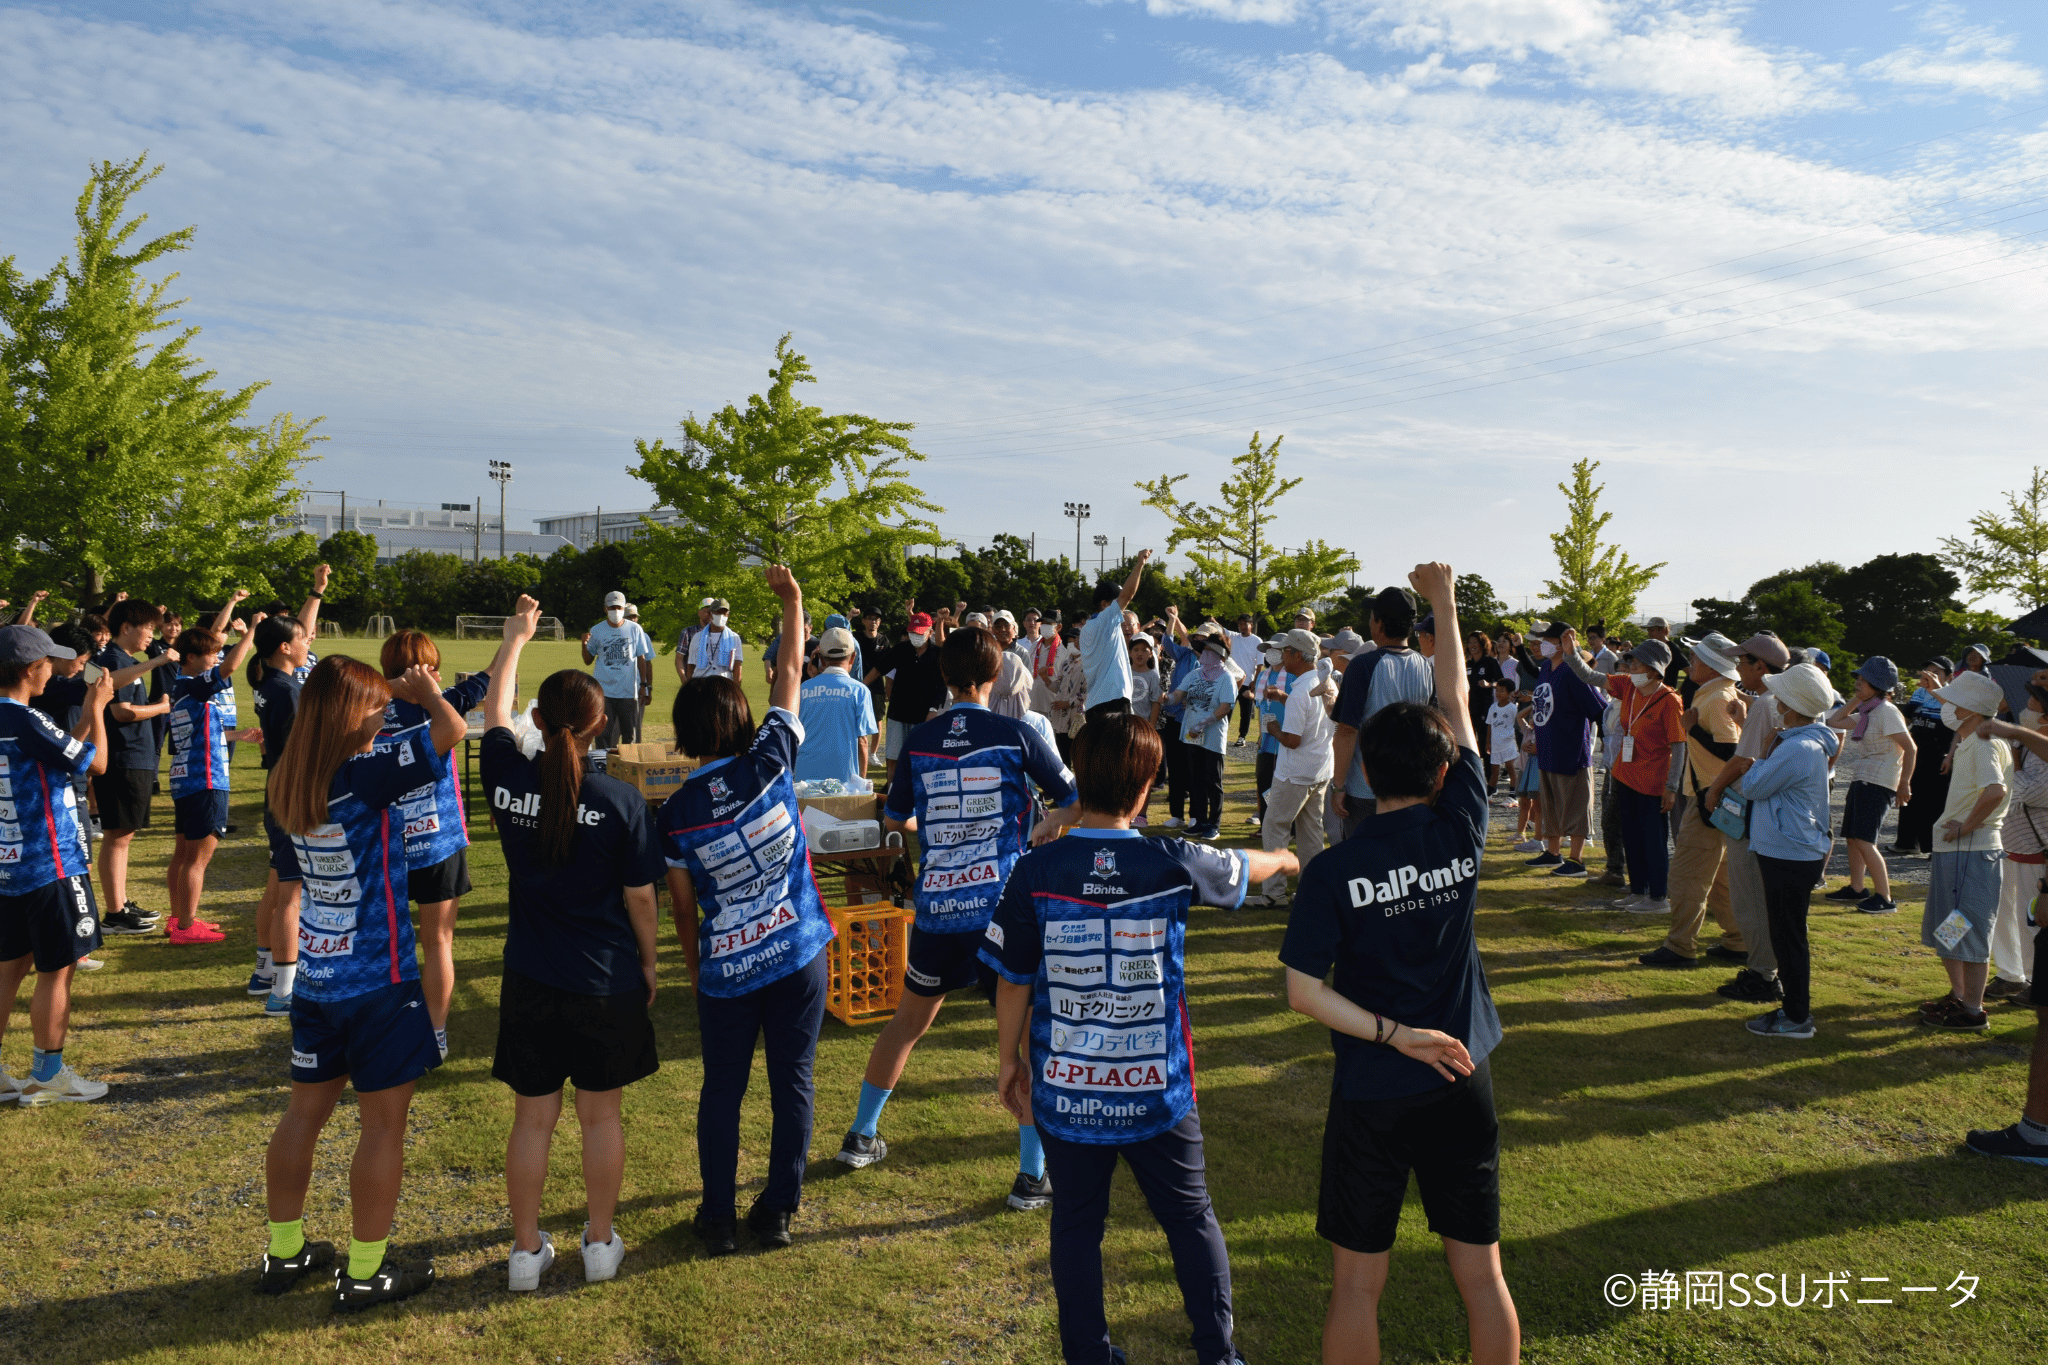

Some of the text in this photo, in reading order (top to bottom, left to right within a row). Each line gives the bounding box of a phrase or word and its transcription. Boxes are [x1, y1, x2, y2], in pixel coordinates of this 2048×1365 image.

[966, 796, 995, 806] GREEN
[966, 803, 996, 814] WORKS
[933, 825, 998, 844] 山下クリニック
[314, 854, 345, 863] GREEN
[317, 862, 349, 873] WORKS
[1082, 883, 1125, 895] Bonita
[1347, 857, 1476, 908] DalPonte
[930, 896, 989, 914] DalPonte
[1384, 889, 1459, 917] DESDE 1930
[721, 940, 791, 977] DalPonte
[764, 955, 784, 968] 1930
[1119, 960, 1158, 971] GREEN
[1119, 970, 1159, 981] WORKS
[1060, 998, 1156, 1018] 山下クリニック
[1072, 1029, 1163, 1052] コクデ化学
[1046, 1060, 1164, 1087] J-PLACA
[1056, 1095, 1148, 1117] DalPonte
[1069, 1117, 1103, 1126] DESDE
